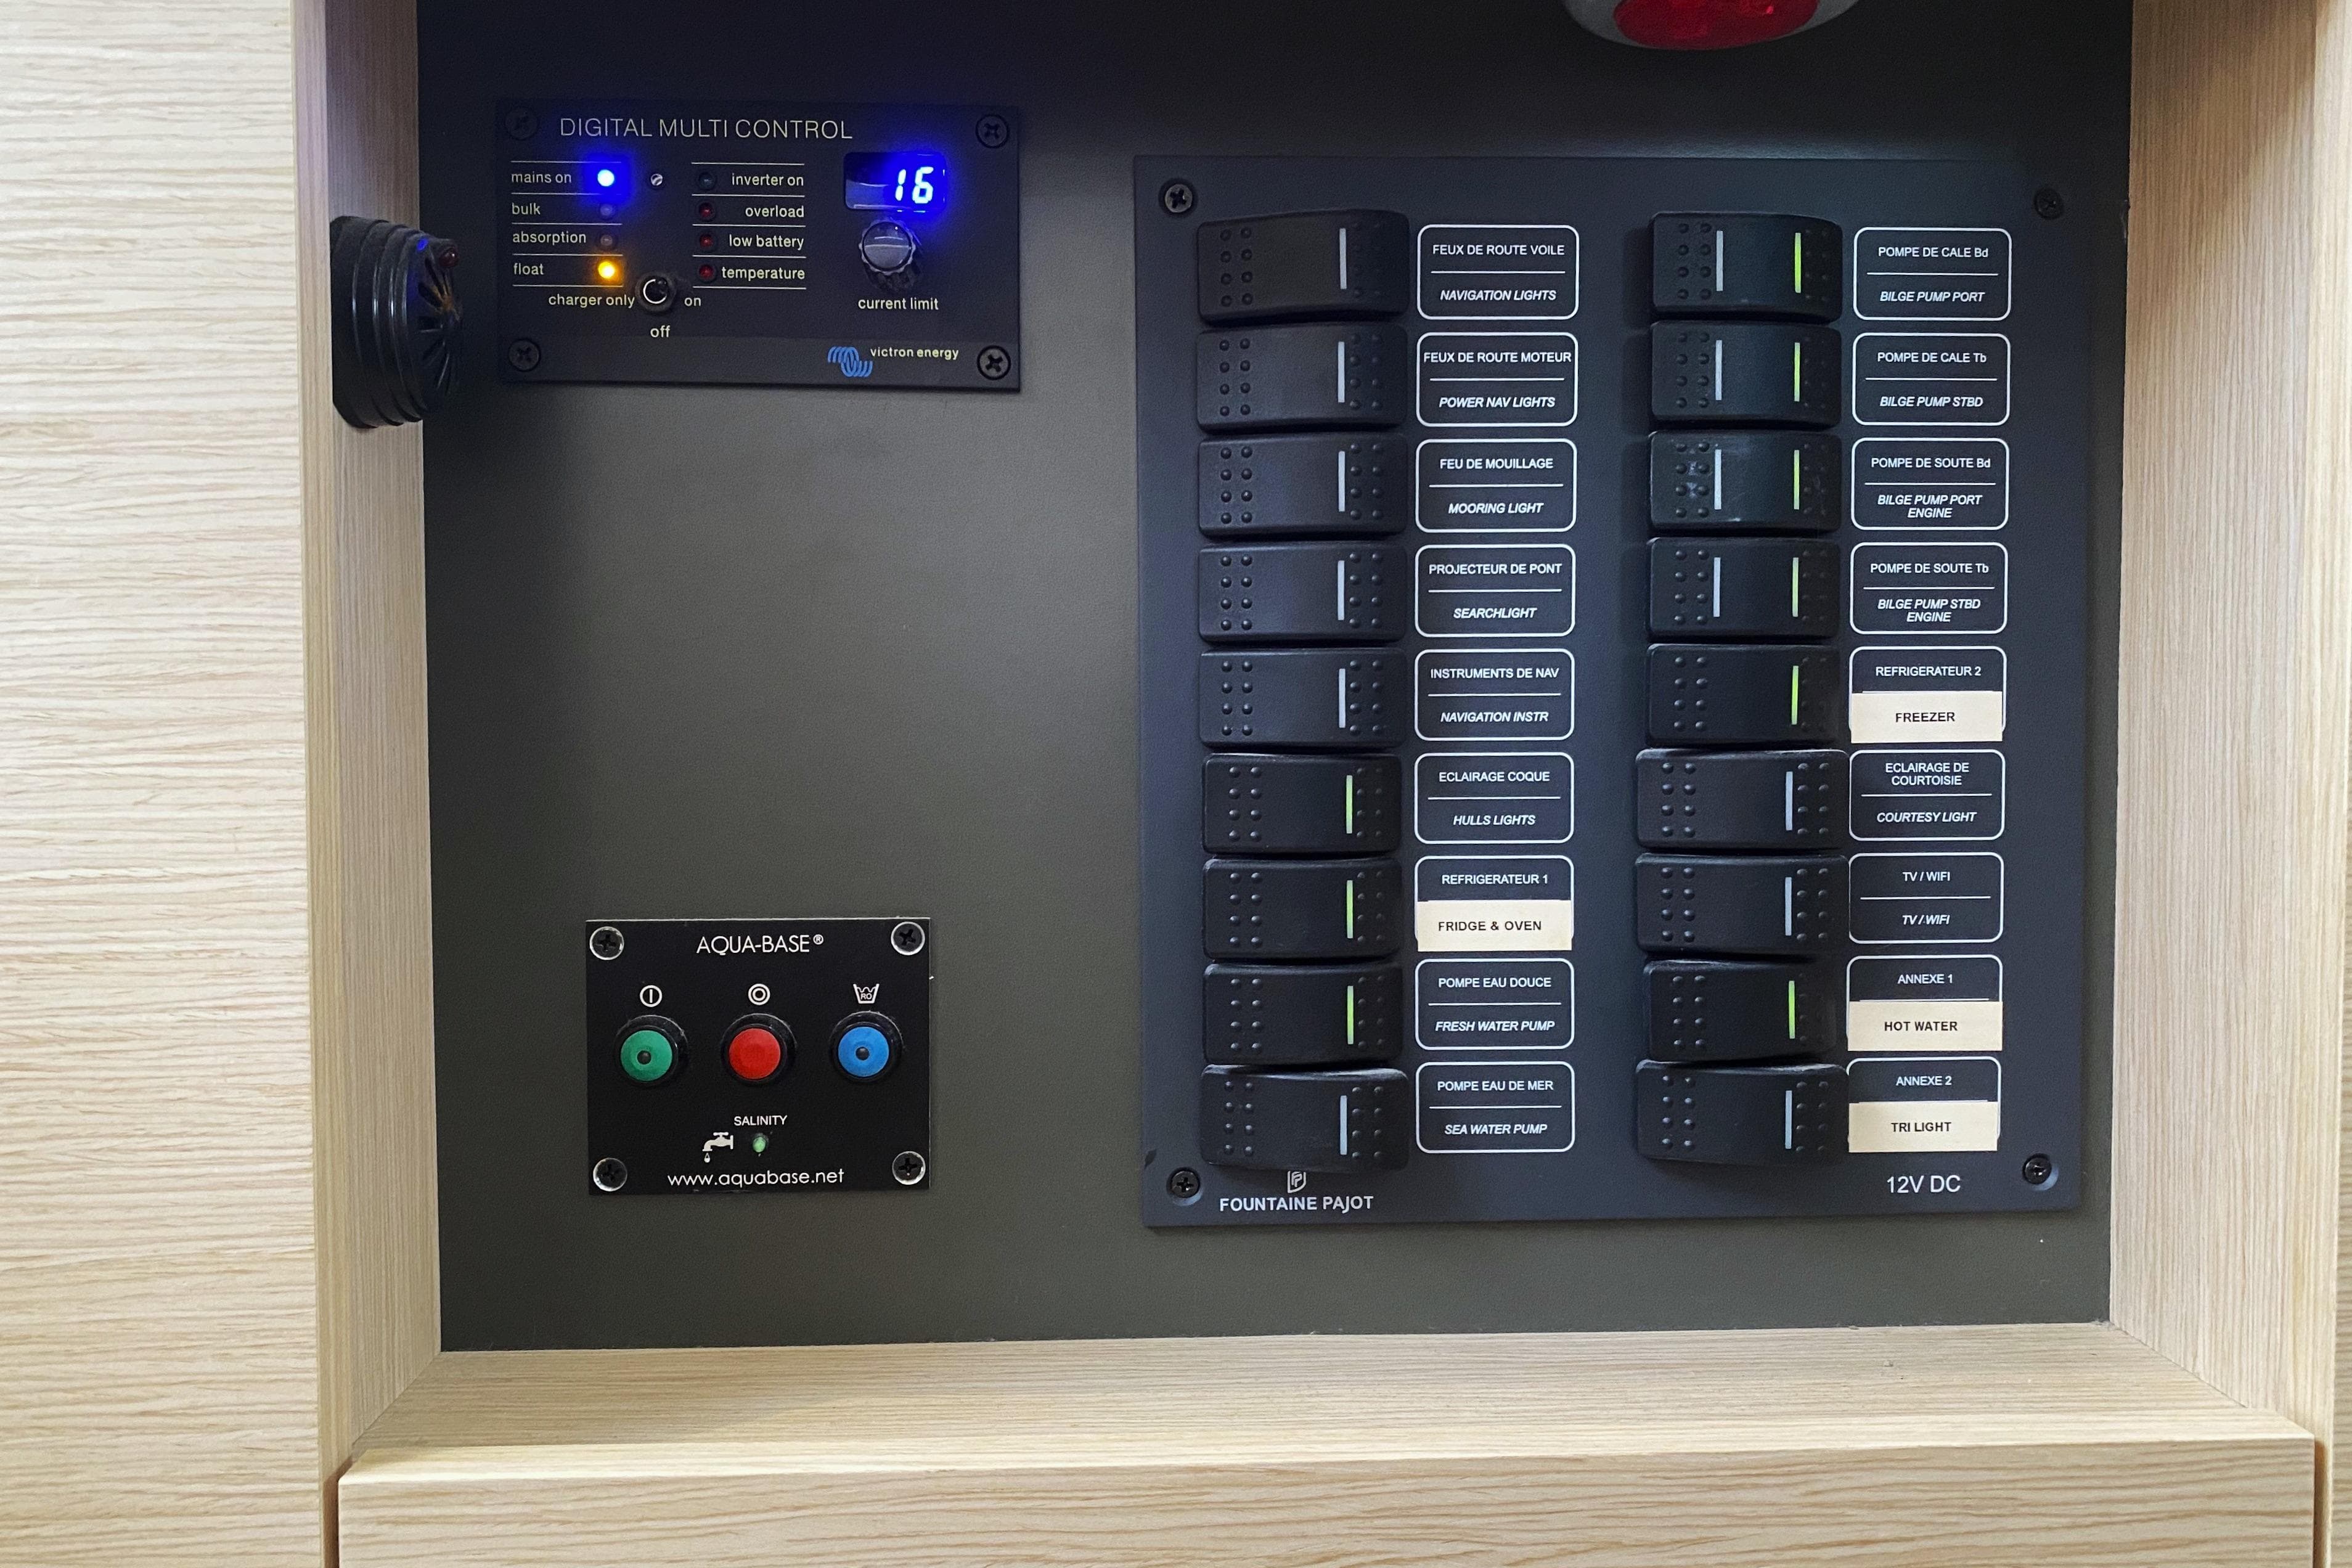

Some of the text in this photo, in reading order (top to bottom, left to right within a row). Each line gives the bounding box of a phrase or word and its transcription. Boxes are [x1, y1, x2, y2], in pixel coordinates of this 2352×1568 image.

[560, 118, 853, 140] DIGITAL MULTI CONTROL
[511, 171, 572, 183] mains on
[731, 173, 804, 186] inverter on
[896, 167, 934, 204] 16
[511, 203, 541, 214] bulk
[745, 205, 805, 217] overload
[512, 231, 587, 245] absorption
[729, 234, 805, 250] low battery
[1433, 245, 1564, 255] FEUX DE ROUTE VOILE
[1879, 247, 1988, 257] POMPE DE CALE Bd
[513, 263, 544, 274] float
[721, 267, 806, 281] temperature
[1440, 290, 1556, 300] NAVIGATION LIGHTS
[1880, 292, 1985, 301] BILGE PUMP PORT
[549, 294, 635, 308] charger only
[684, 298, 702, 306] on
[857, 298, 939, 309] current limit
[650, 325, 671, 337] off
[870, 347, 959, 360] victron energy
[1424, 352, 1571, 362] FEUX DE ROUTE MOTEUR
[1877, 353, 1987, 362] POMPE DE CALE Tb
[1439, 397, 1555, 407] POWER NAV LIGHTS
[1880, 396, 1983, 407] BILGE PUMP STBD
[1440, 459, 1553, 469] FEU DE MOUILLAGE
[1871, 458, 1990, 468] POMPE DE SOUTE Bd
[1877, 495, 1983, 505] BILGE PUMP PORT
[1448, 503, 1544, 513] MOORING LIGHT
[1908, 508, 1953, 518] ENGINE
[1429, 563, 1562, 574] PROJECTEUR DE PONT
[1871, 563, 1988, 573] POMPE DE SOUTE Tb
[1877, 599, 1981, 609] BILGE PUMP STBD
[1453, 608, 1537, 618] SEARCHLIGHT
[1906, 612, 1951, 622] ENGINE
[1431, 668, 1559, 678] INSTRUMENTS DE NAV
[1876, 666, 1981, 676] REFRIGERATEUR 2
[1440, 712, 1548, 722] NAVIGATION INSTR
[1895, 713, 1955, 722] FREEZER
[1885, 762, 1969, 772] ECLAIRAGE DE
[1439, 772, 1550, 782] ECLAIRAGE COQUE
[1892, 775, 1962, 785] COURTOISIE
[1453, 815, 1536, 825] HULLS LIGHTS
[1877, 812, 1977, 822] COURTESY LIGHT
[1442, 875, 1548, 884] REFRIGERATEUR 1
[1903, 872, 1917, 881] TV
[1927, 872, 1950, 881] WIFI
[1903, 915, 1917, 925] TV
[1925, 915, 1950, 925] WIFI
[1439, 921, 1541, 931] FRIDGE & OVEN
[1439, 978, 1551, 987] POMPE EAU DOUCE
[1898, 974, 1952, 984] ANNEXE 1
[1435, 1021, 1555, 1031] FRESH WATER PUMP
[1884, 1022, 1958, 1031] HOT WATER
[1437, 1080, 1553, 1091] POMPE EAU DE MER
[1896, 1076, 1951, 1085] ANNEXE 2
[733, 1116, 787, 1125] SALINITY
[1445, 1124, 1547, 1134] SEA WATER PUMP
[1891, 1122, 1951, 1132] TRI LIGHT
[668, 1169, 844, 1187] www.aquabase.net
[1887, 1175, 1961, 1193] 12V DC
[1220, 1196, 1374, 1214] FOUNTAINE PAJOT
